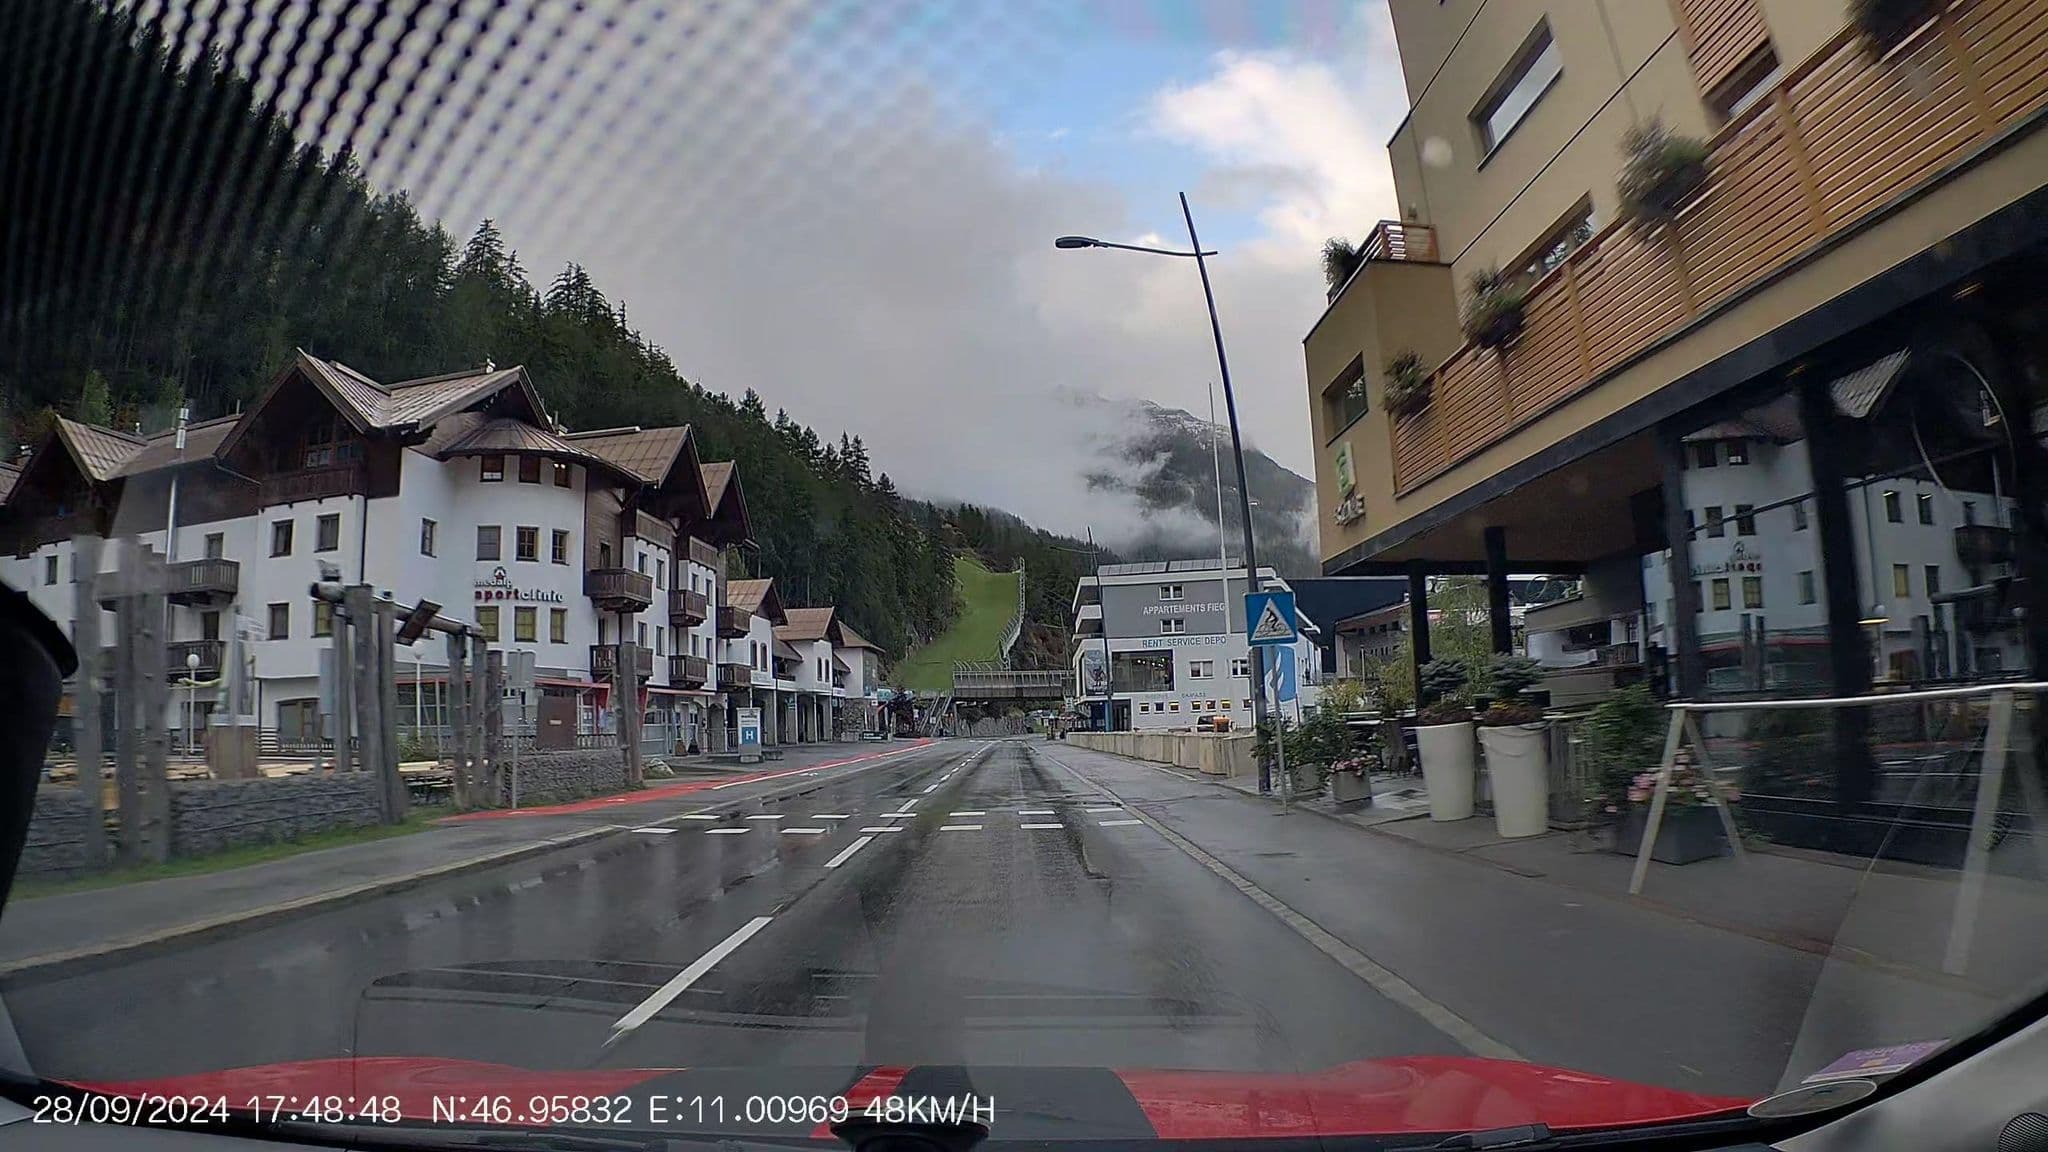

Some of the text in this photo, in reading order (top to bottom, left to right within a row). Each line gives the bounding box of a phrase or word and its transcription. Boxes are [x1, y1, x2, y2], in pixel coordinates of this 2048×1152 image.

[1143, 602, 1226, 616] APPARTEMENTS FIEG
[1142, 636, 1227, 648] RENT SERVICE DEPO
[745, 730, 754, 740] H
